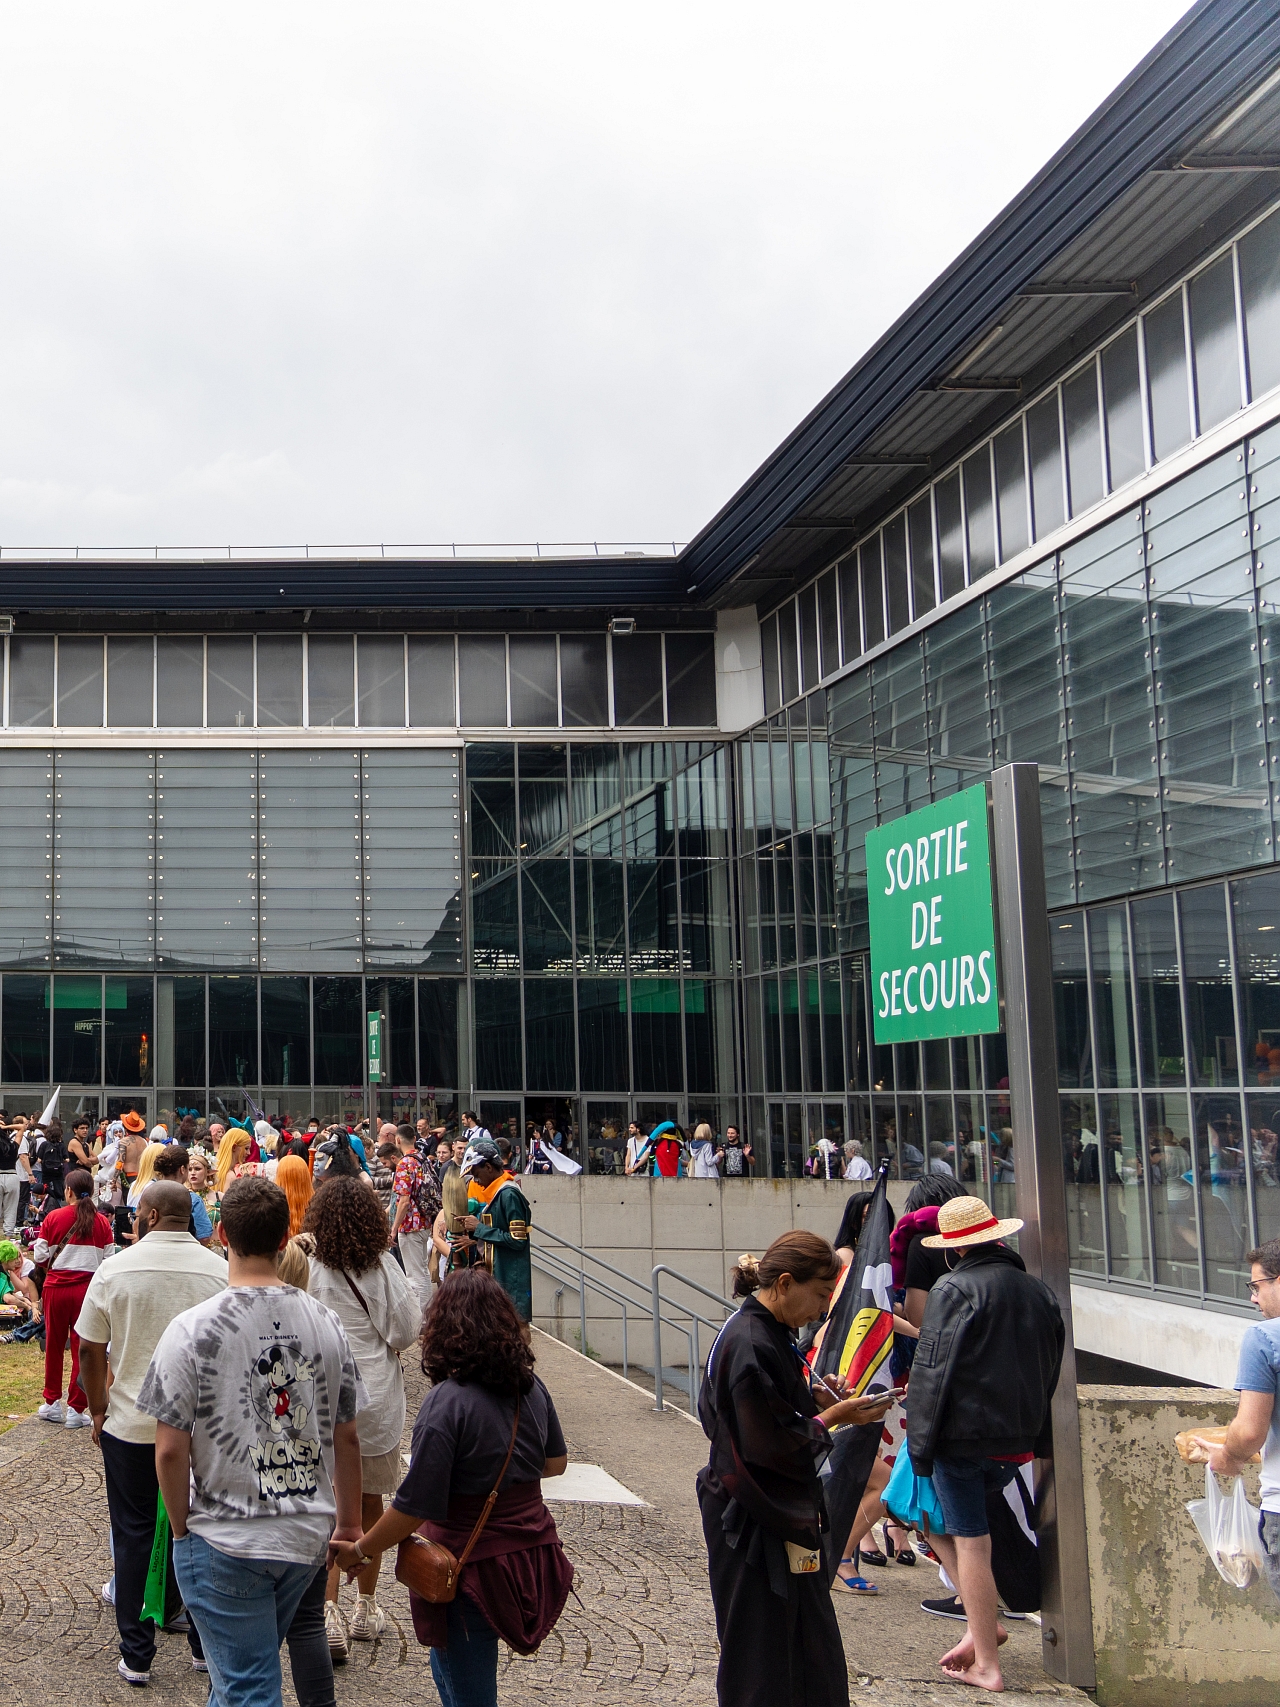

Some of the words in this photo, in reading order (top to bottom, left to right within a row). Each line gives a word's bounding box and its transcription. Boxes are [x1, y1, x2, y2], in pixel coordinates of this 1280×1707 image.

[884, 820, 968, 896] SORTIE
[911, 895, 942, 950] DE
[878, 950, 991, 1018] SECOURS
[248, 1438, 321, 1472] MICKEY
[259, 1463, 317, 1501] MOUSE
